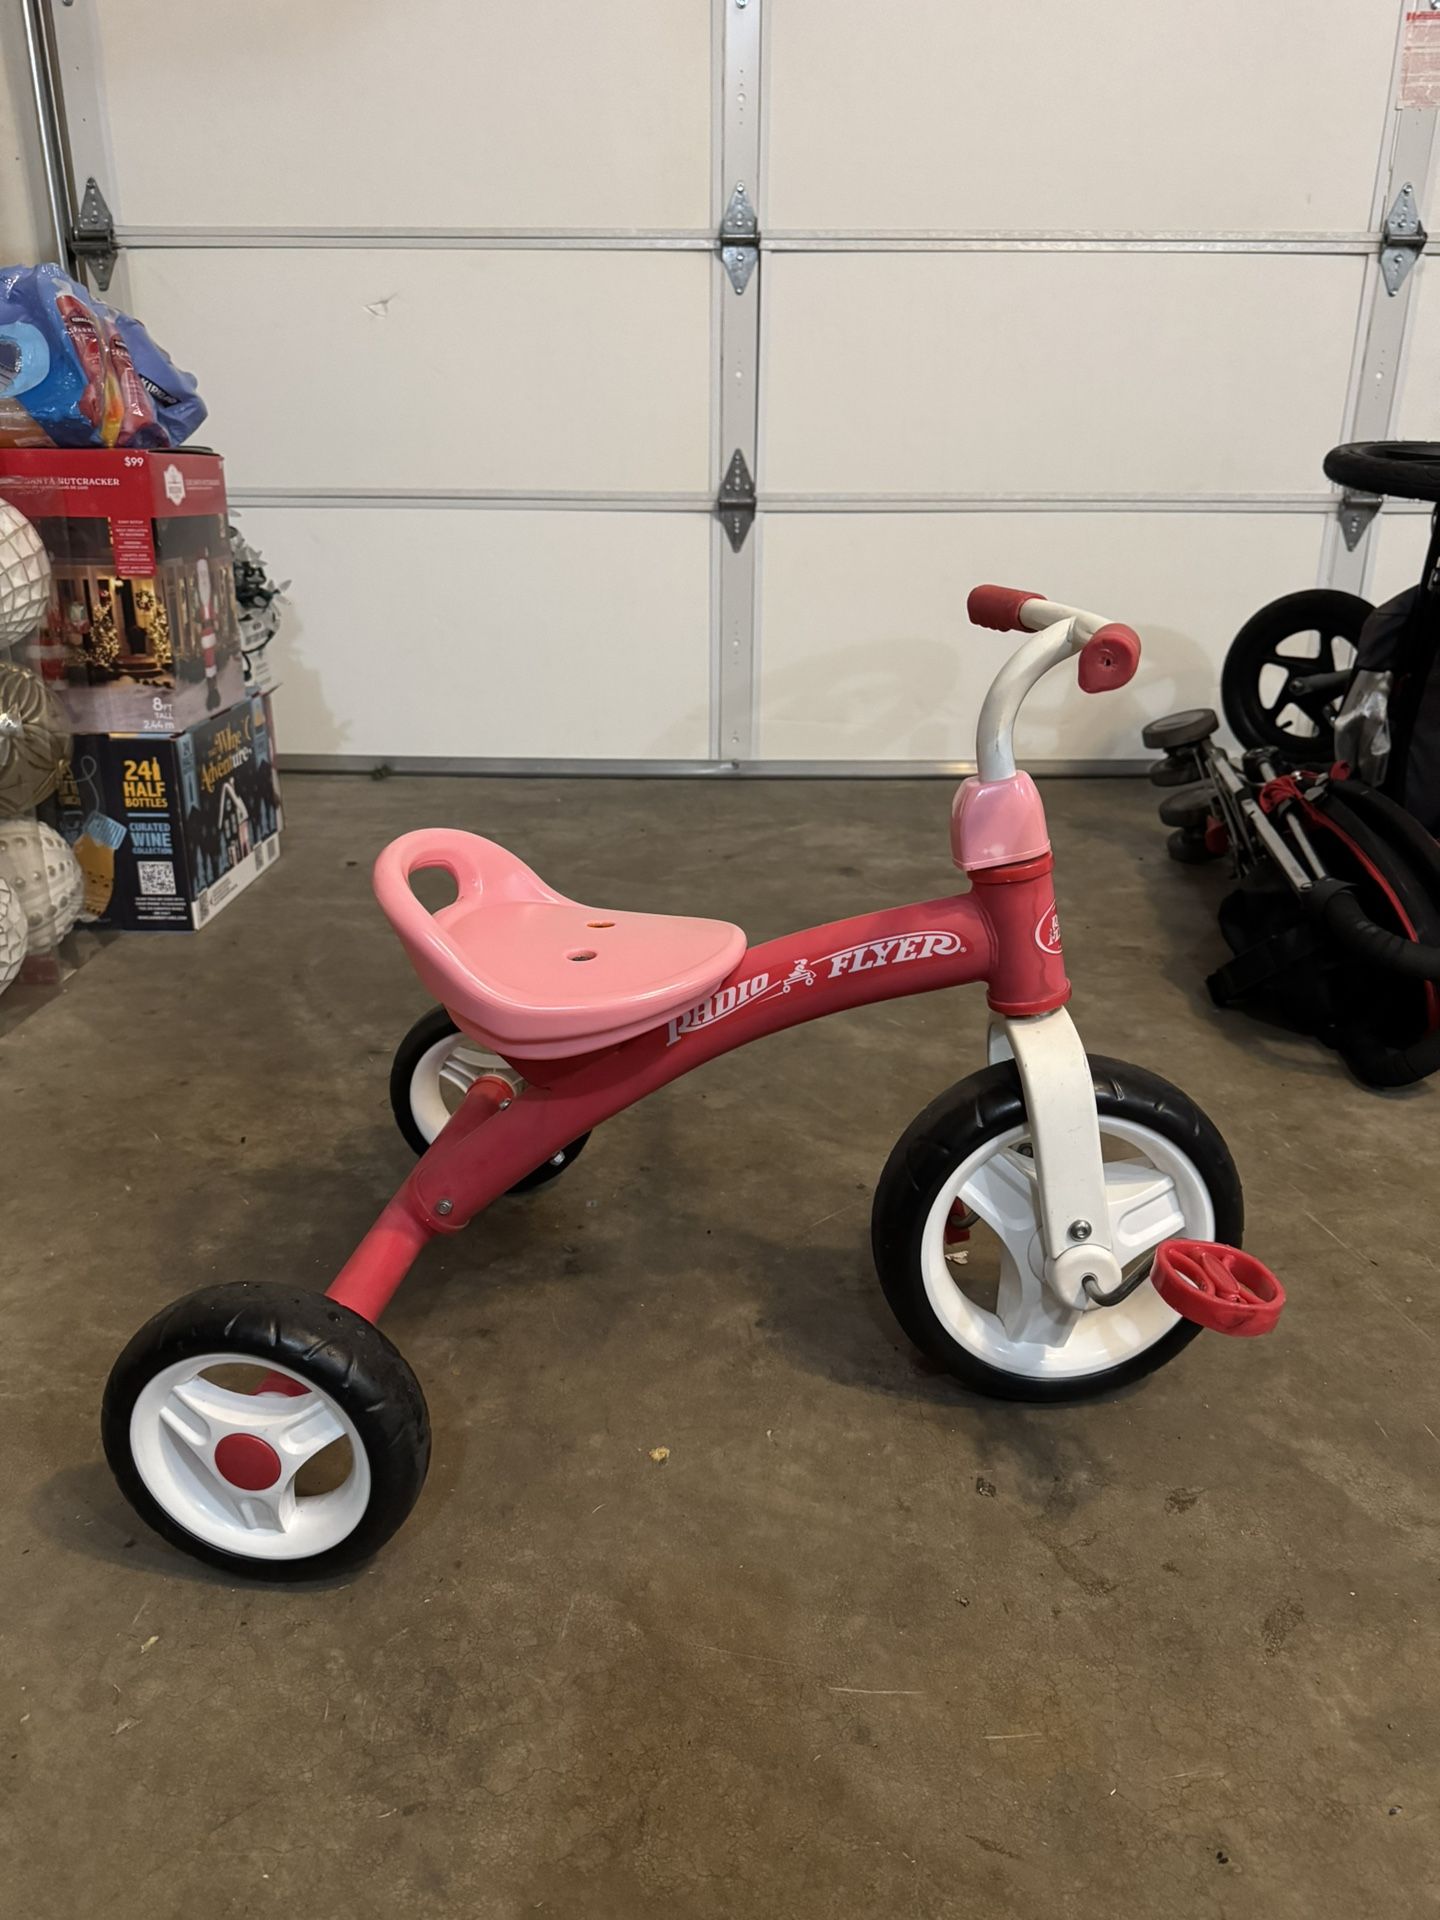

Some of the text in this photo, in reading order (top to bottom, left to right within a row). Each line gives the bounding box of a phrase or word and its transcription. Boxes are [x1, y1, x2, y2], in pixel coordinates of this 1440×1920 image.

[124, 456, 144, 467] $99
[59, 477, 120, 486] NUTCRACKER
[124, 760, 153, 781] 24
[123, 781, 166, 797] HALF
[124, 797, 168, 808] BOTTLES
[129, 822, 171, 832] CURATED
[130, 832, 173, 848] WINE
[666, 932, 961, 1047] RADIO FLYER
